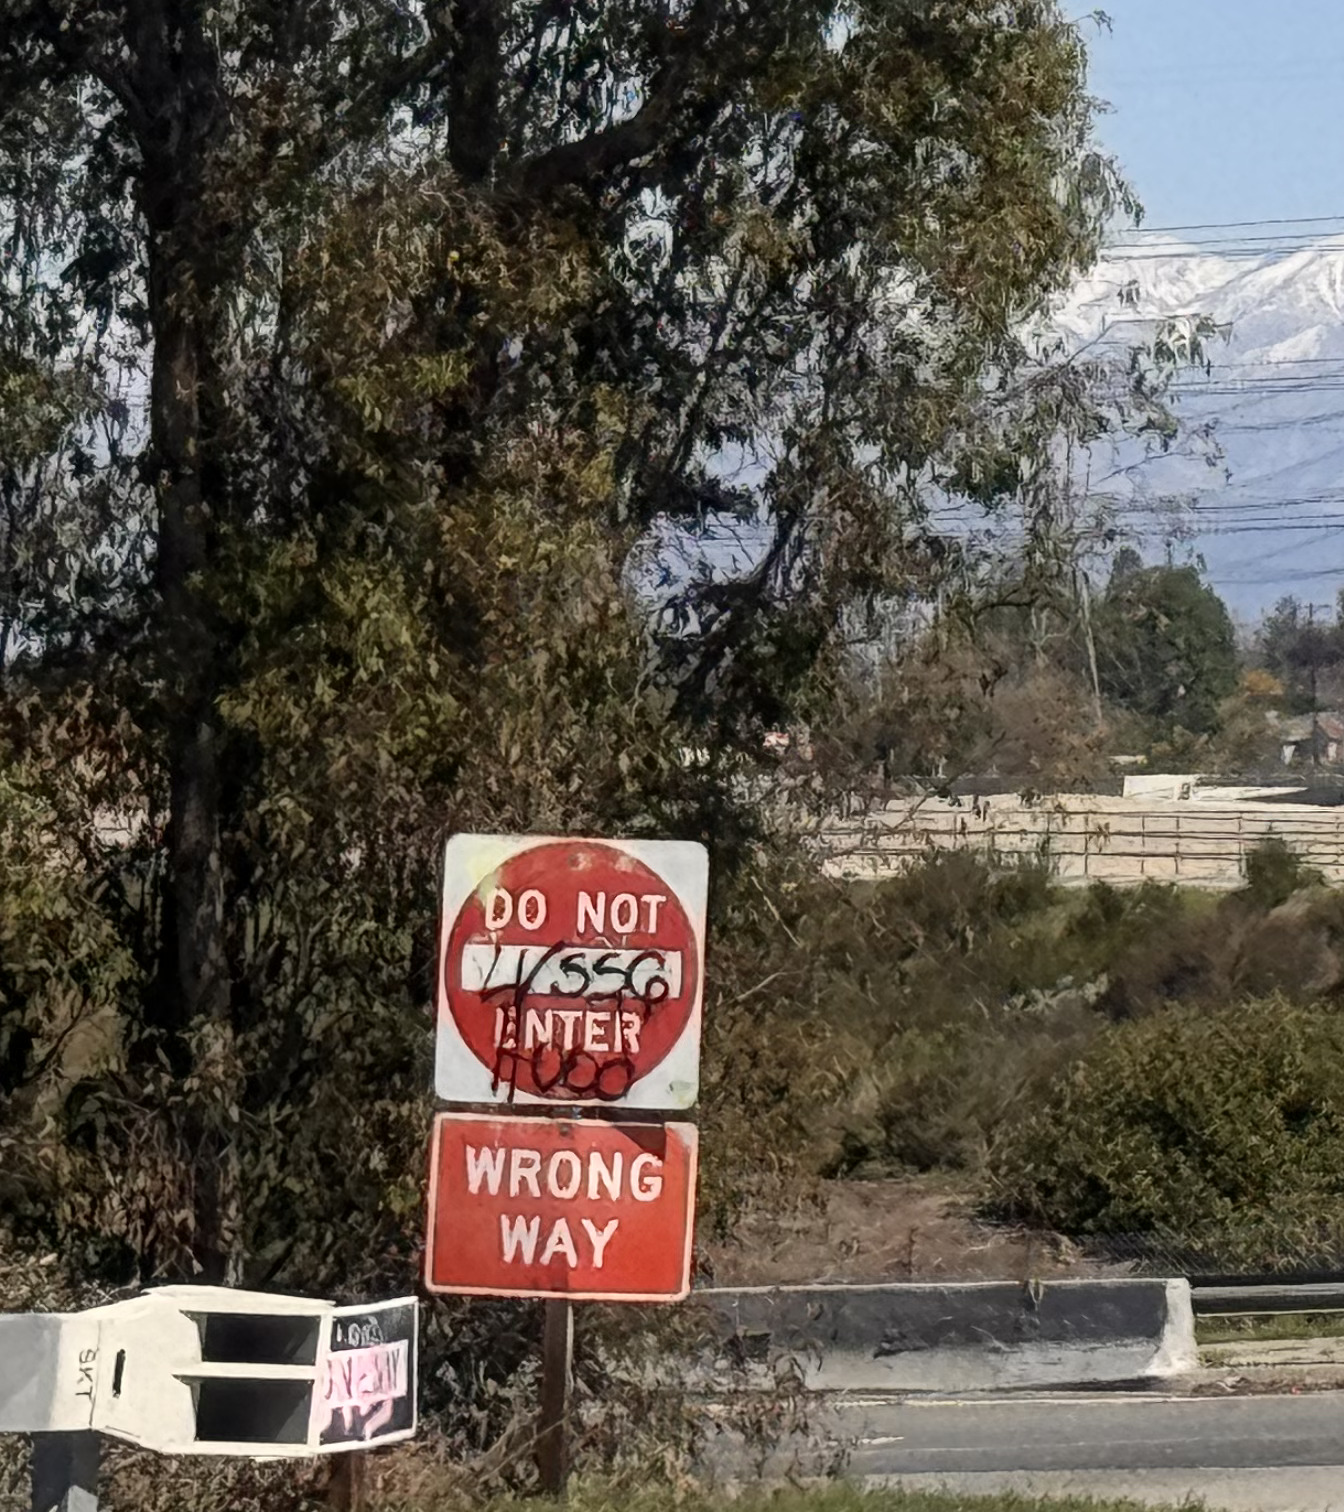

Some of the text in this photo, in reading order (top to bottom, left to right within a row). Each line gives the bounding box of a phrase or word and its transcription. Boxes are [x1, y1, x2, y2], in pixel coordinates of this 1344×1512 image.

[484, 888, 668, 936] DO NOT
[494, 1008, 640, 1054] ENTER
[465, 1144, 665, 1203] WRONG
[500, 1214, 620, 1270] WAY
